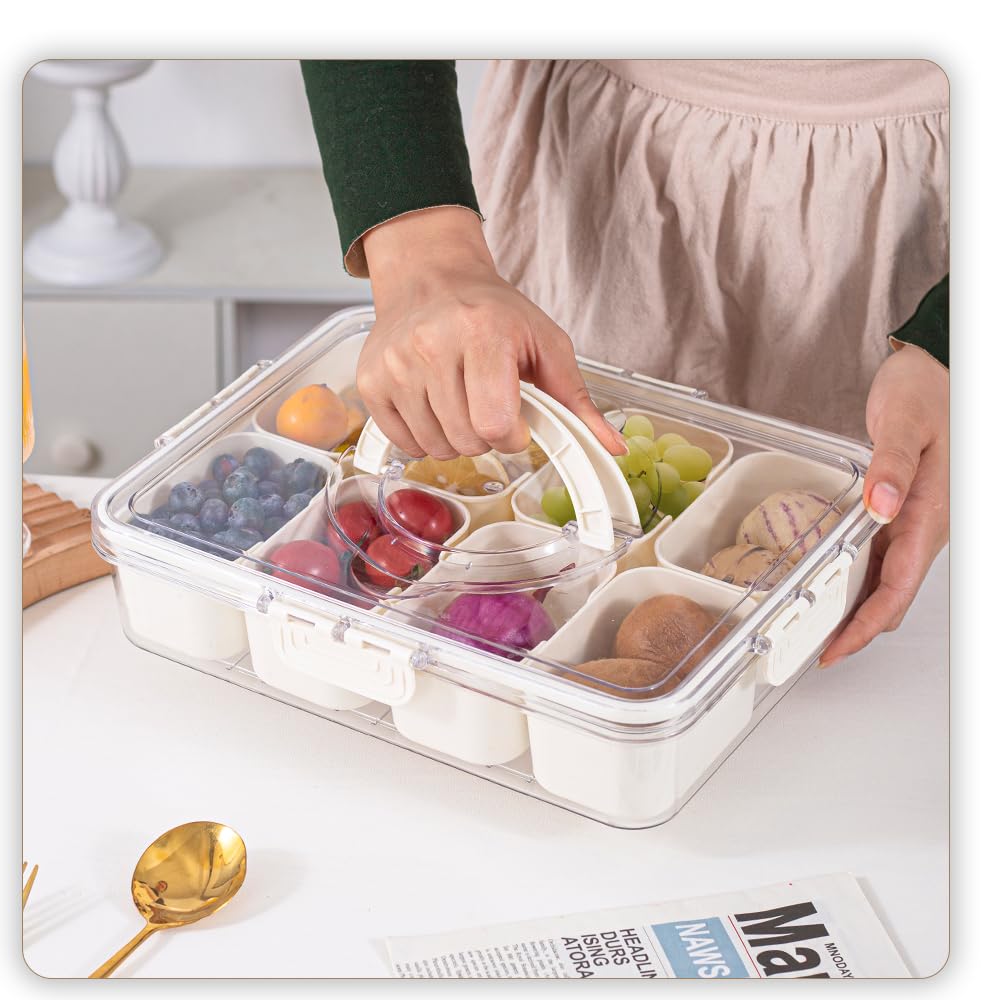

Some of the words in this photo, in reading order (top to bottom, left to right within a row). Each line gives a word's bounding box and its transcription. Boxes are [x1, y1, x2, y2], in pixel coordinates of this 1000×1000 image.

[561, 937, 595, 978] ATORA
[581, 934, 609, 967] ISING
[600, 931, 630, 966] DURS
[675, 922, 731, 978] NAWS
[734, 901, 831, 978] Ma
[824, 942, 854, 978] MNODAY
